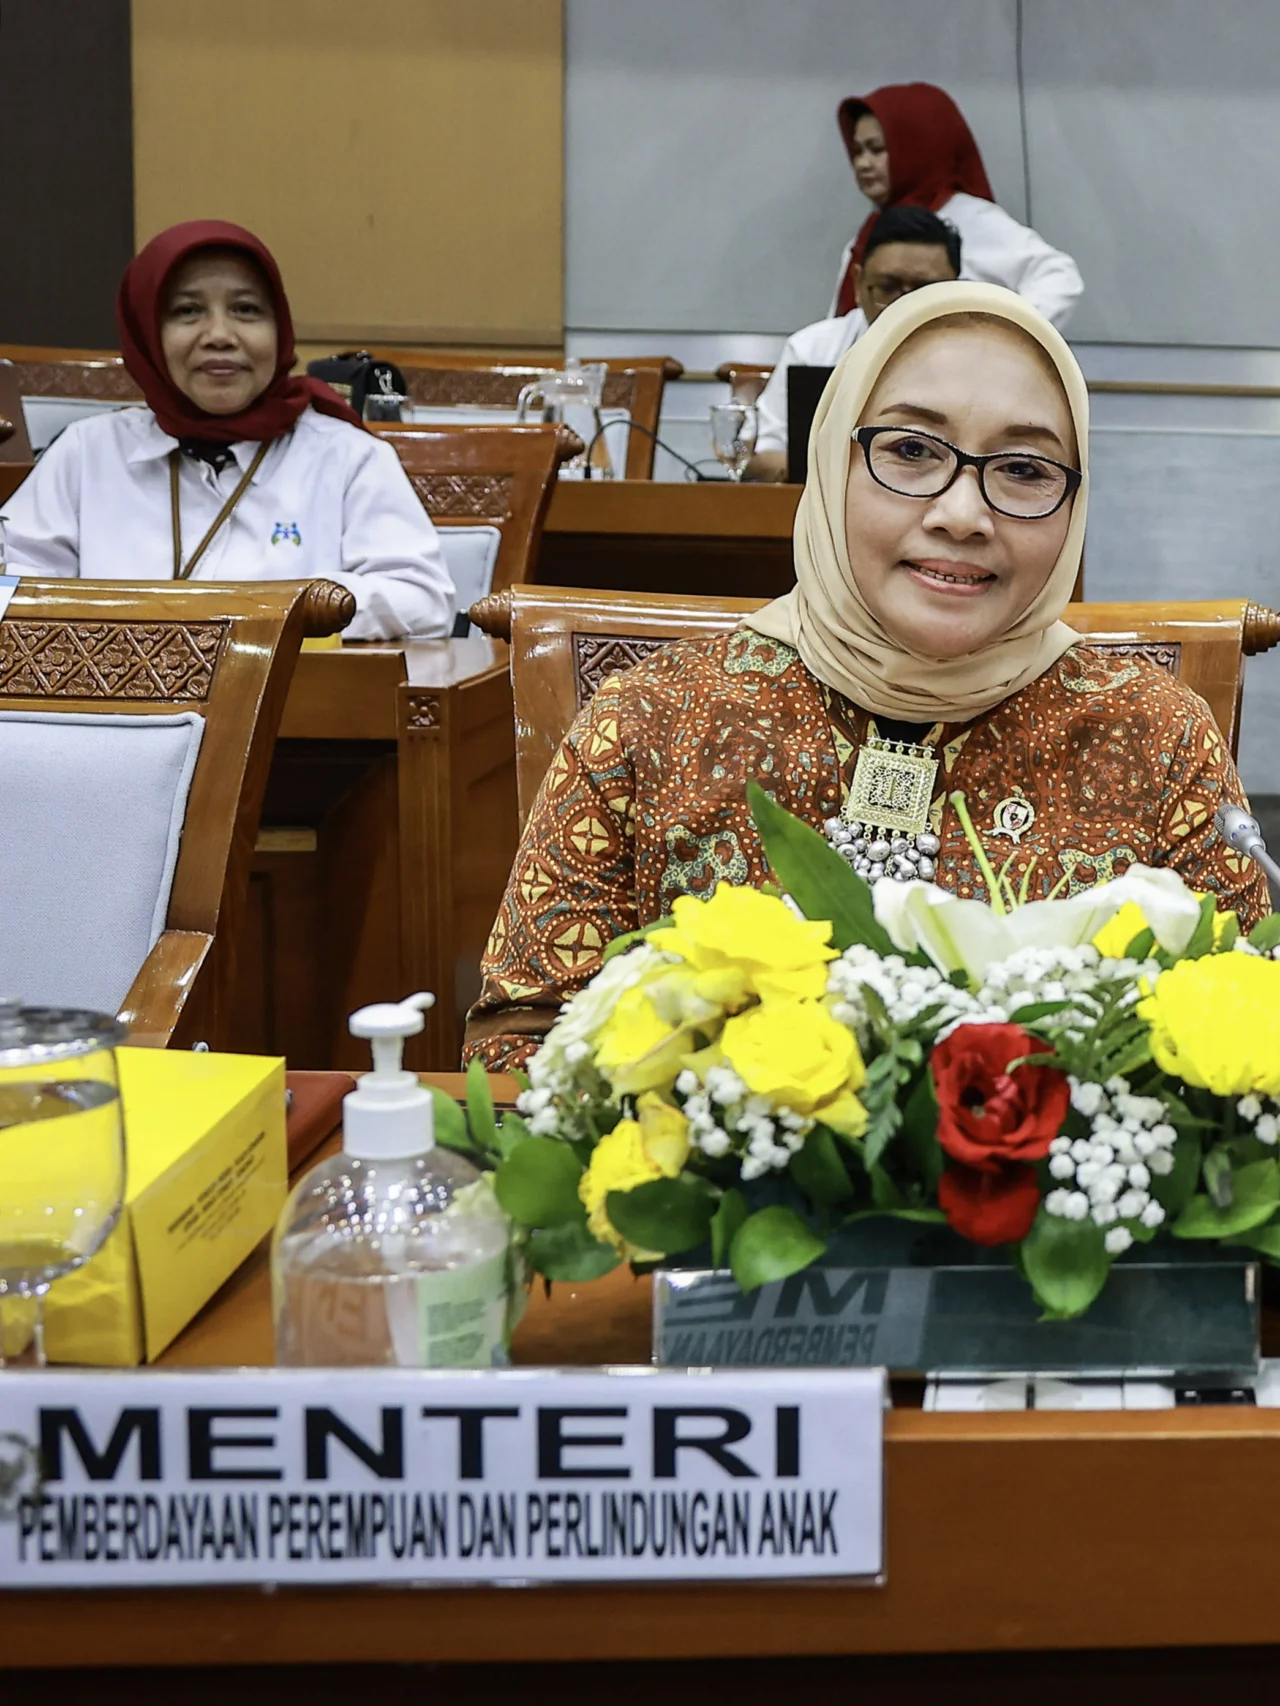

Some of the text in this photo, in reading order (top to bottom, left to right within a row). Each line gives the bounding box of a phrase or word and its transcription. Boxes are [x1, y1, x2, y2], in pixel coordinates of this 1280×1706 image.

[38, 1404, 801, 1481] MENTERI
[18, 1488, 839, 1562] PEMBERDAYAAN PEREMPUAN DAN PERLINDUNGAN ANAK
